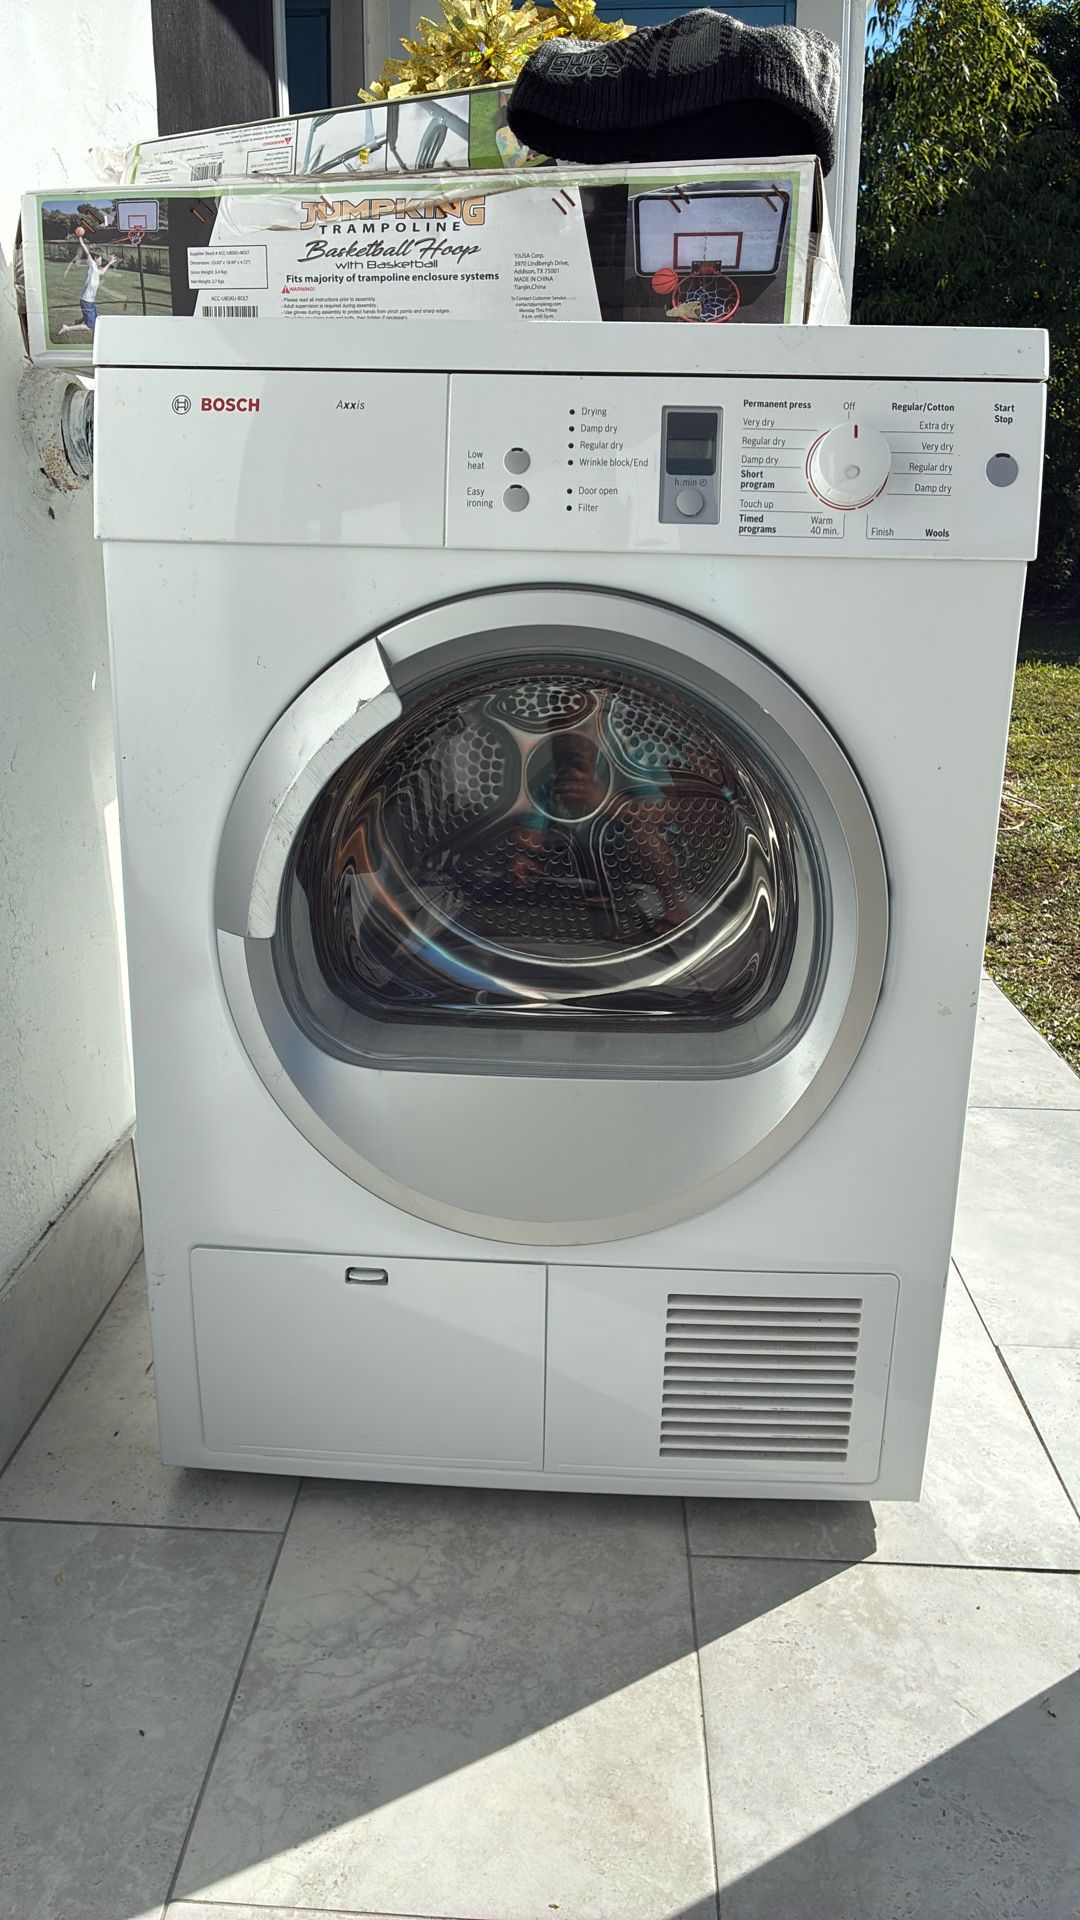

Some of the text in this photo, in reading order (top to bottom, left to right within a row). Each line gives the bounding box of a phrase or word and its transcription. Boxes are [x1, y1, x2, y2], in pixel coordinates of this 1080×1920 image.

[300, 196, 486, 230] JUMPKING
[319, 221, 461, 235] TRAMPOLINE
[297, 237, 482, 264] Basketball Hoop
[335, 259, 438, 269] with Basketball
[286, 272, 500, 285] Fits majority of trampoline enclosure systems
[201, 398, 260, 412] BOSCH
[335, 400, 365, 410] Axxis
[743, 399, 812, 410] Permanent press
[843, 402, 856, 411] Off
[891, 402, 955, 413] Regular/Cotton
[994, 404, 1015, 412] Start
[581, 407, 607, 417] Drying
[743, 418, 775, 428] Very dry
[994, 415, 1014, 425] Stop
[580, 424, 618, 434] Damp dry
[919, 421, 955, 432] Extra dry
[580, 441, 624, 451] Regular dry
[742, 436, 786, 447] Regular dry
[921, 442, 954, 452] Very dry
[467, 450, 483, 459] Low
[579, 458, 649, 467] Wrinkle block/End
[741, 455, 779, 465] Damp dry
[467, 461, 485, 470] heat
[909, 462, 953, 473] Regular dry
[741, 469, 764, 478] Short
[674, 478, 698, 487] h:min
[740, 480, 775, 490] program
[467, 487, 485, 497] Easy
[578, 487, 618, 496] Door open
[914, 483, 952, 494] Damp dry
[466, 499, 494, 509] ironing
[578, 504, 599, 512] Filter
[740, 499, 774, 510] Touch up
[739, 514, 764, 523] Timed
[810, 516, 833, 525] Warm
[738, 525, 777, 534] programs
[810, 526, 839, 535] 40 min.
[871, 528, 894, 537] Finish
[925, 528, 950, 538] Wools
